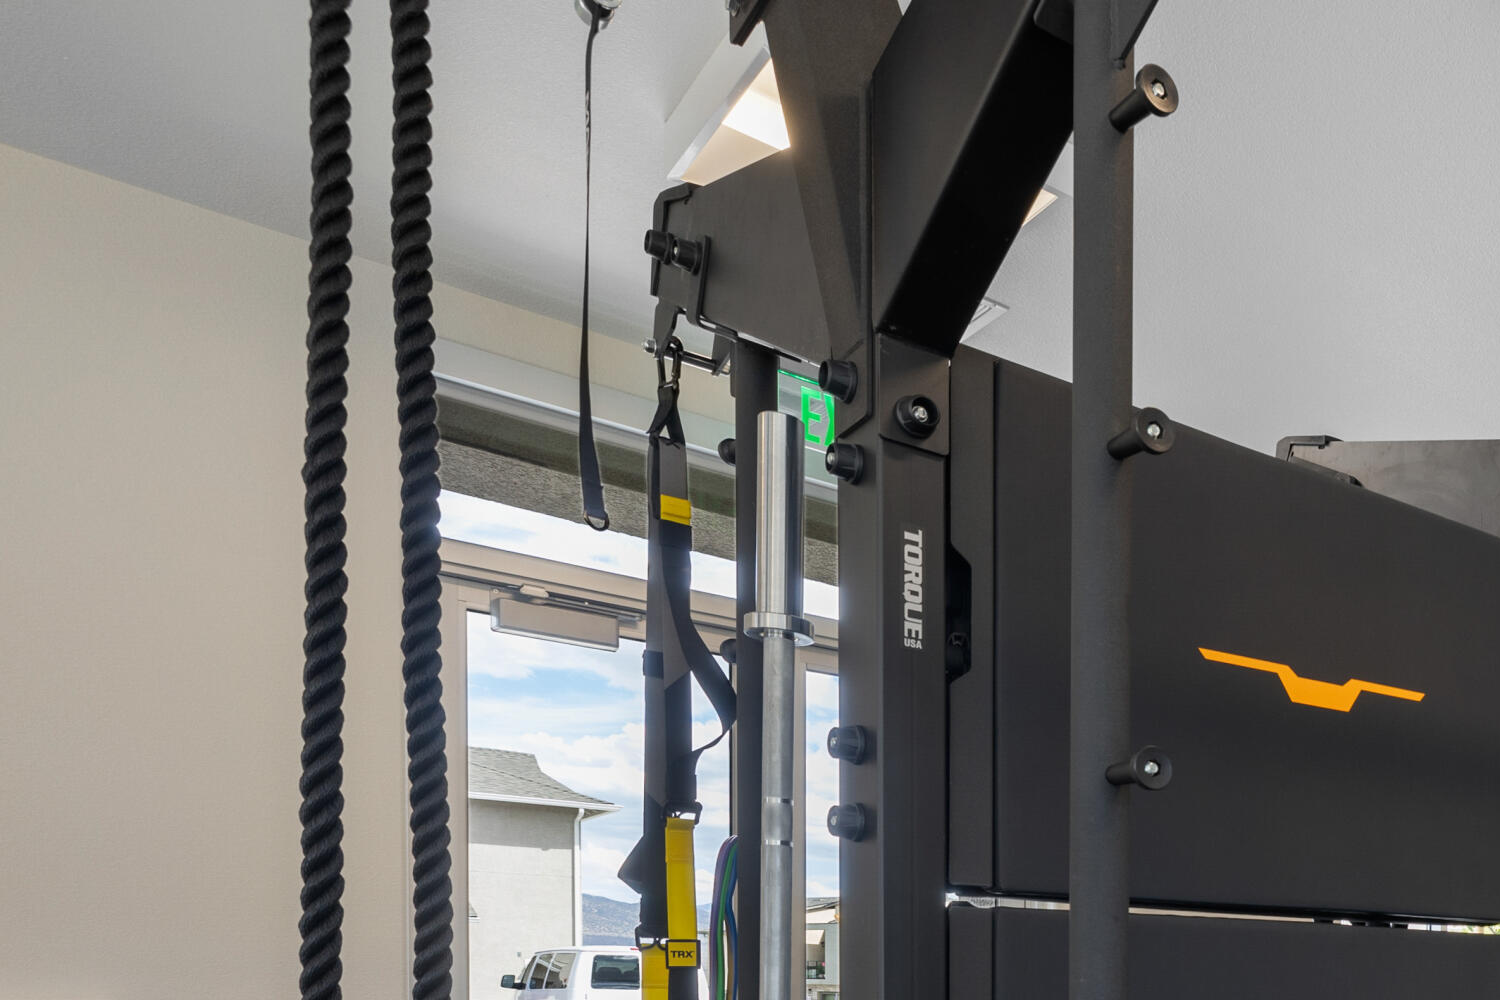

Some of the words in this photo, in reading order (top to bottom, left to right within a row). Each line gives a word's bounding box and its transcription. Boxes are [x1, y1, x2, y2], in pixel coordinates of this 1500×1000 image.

[902, 530, 922, 640] TORQUE
[903, 637, 923, 650] USA
[670, 950, 693, 959] TRX
